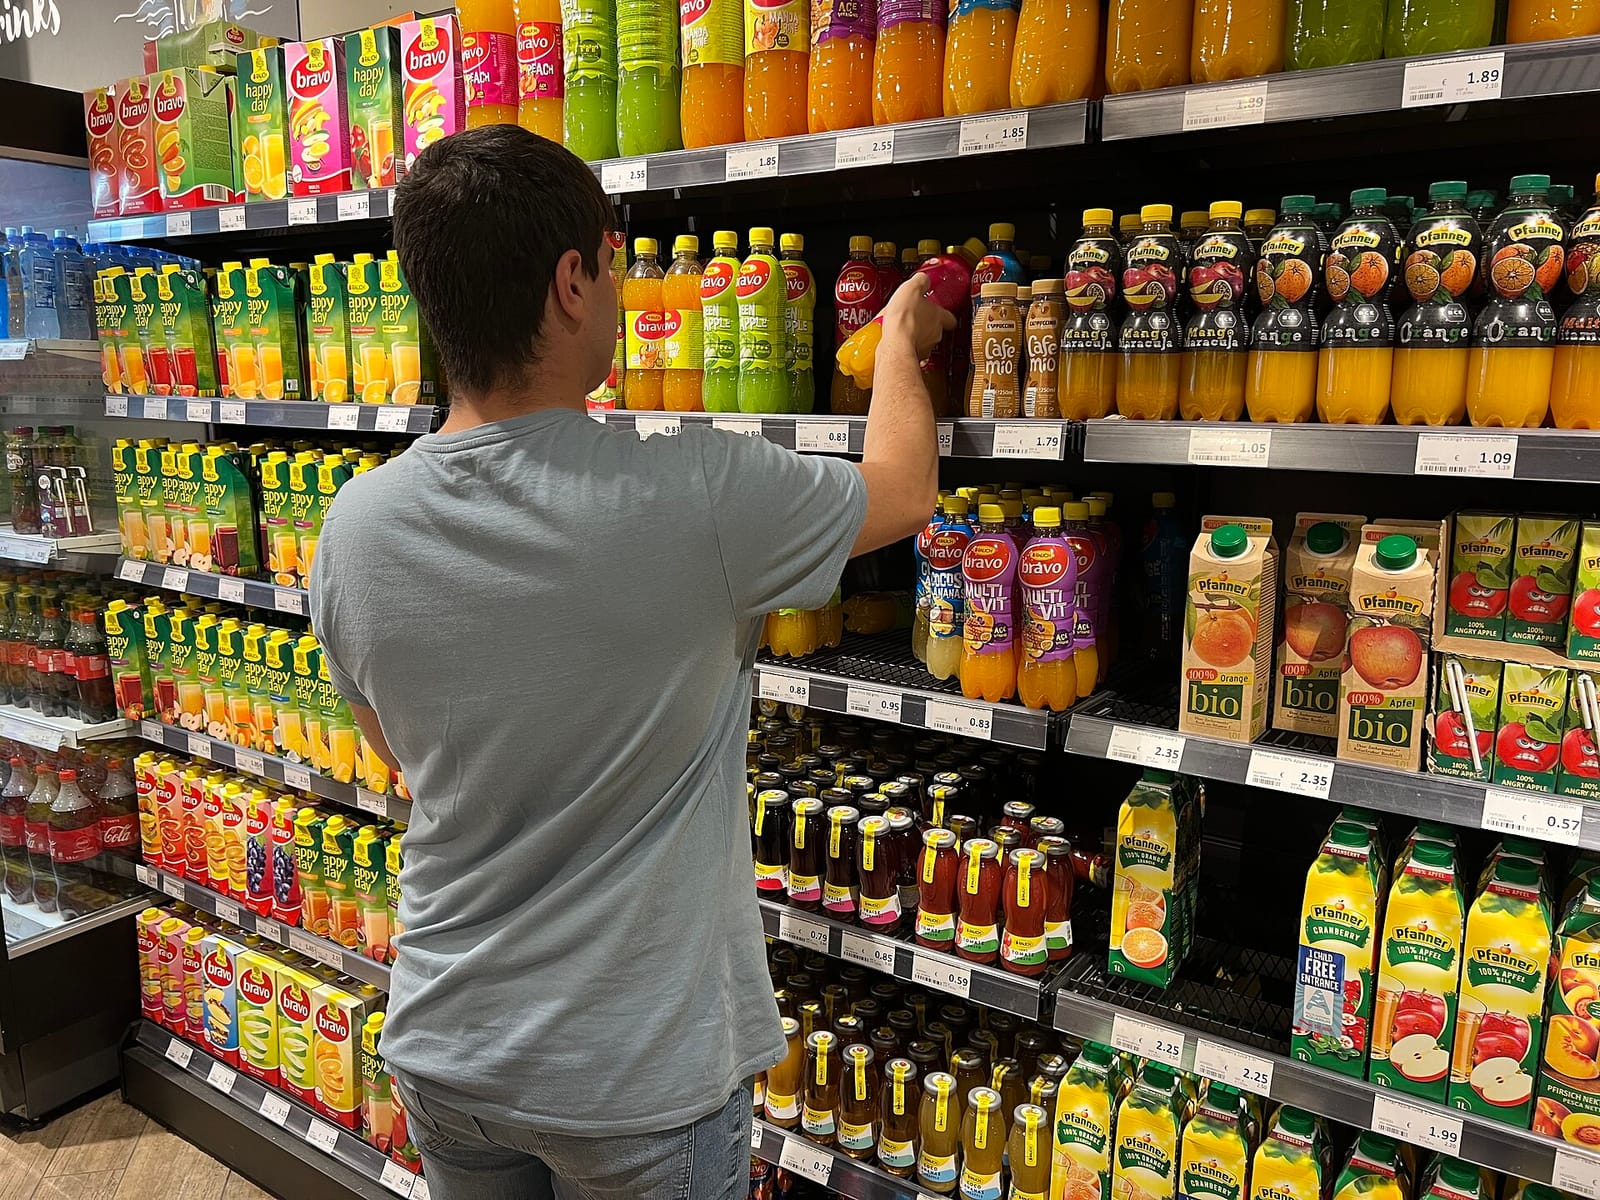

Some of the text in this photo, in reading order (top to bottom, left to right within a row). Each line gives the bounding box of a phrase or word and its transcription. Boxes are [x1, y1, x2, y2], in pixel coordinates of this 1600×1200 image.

[410, 51, 446, 70] bravo
[353, 66, 384, 84] happy
[527, 63, 554, 75] PEACH
[296, 70, 330, 89] bravo
[1467, 70, 1499, 84] 1.89
[245, 83, 273, 100] happy
[359, 83, 378, 98] day
[122, 103, 148, 118] bravo
[157, 93, 183, 113] bravo
[251, 99, 269, 114] day
[91, 112, 114, 127] bravo
[1002, 126, 1024, 139] 1.85
[873, 141, 892, 151] 2.55
[759, 156, 776, 167] 1.85
[630, 170, 645, 179] 2.55
[1421, 233, 1468, 244] Pfanner
[1513, 226, 1561, 239] Pfanner
[839, 282, 870, 293] bravo
[380, 294, 409, 311] appy
[312, 310, 327, 325] day
[350, 309, 369, 325] day
[382, 309, 401, 324] day
[839, 309, 872, 324] PEACH
[1064, 329, 1108, 338] Mango
[1122, 328, 1169, 339] Mango
[1188, 328, 1234, 338] Mango
[985, 337, 1015, 358] Cafe
[1028, 335, 1058, 355] Cafe
[986, 358, 1013, 374] mio
[1030, 356, 1055, 371] mio
[829, 432, 847, 442] 0.83
[1036, 437, 1058, 446] 1.79
[1240, 444, 1266, 453] 1.05
[1480, 453, 1511, 464] 1.09
[264, 503, 281, 516] day
[930, 546, 961, 558] bravo
[1462, 543, 1506, 555] Pfanner
[1522, 546, 1568, 560] Pfanner
[965, 556, 1002, 569] bravo
[1022, 562, 1061, 574] bravo
[966, 584, 1001, 598] MULTI
[1199, 578, 1247, 594] Pfanner
[1295, 578, 1344, 591] Pfanner
[1022, 588, 1063, 604] MULTI
[981, 597, 1004, 611] VIT
[1041, 603, 1065, 620] VIT
[1363, 597, 1419, 614] Pfanner
[1513, 632, 1556, 642] ANGRY APPLE
[220, 666, 235, 680] day
[1189, 670, 1248, 683] 100% Orange
[296, 688, 312, 703] day
[789, 685, 806, 694] 0.83
[1286, 682, 1333, 711] bio
[1466, 683, 1492, 696] nner
[882, 700, 900, 711] 0.95
[1191, 683, 1238, 716] bio
[1349, 694, 1415, 708] 100% Apfel
[1509, 692, 1558, 708] Pfanner
[970, 717, 990, 728] 0.83
[1353, 709, 1408, 745] bio
[1155, 747, 1179, 758] 2.35
[1300, 773, 1327, 786] 2.35
[1502, 780, 1547, 792] ANGRY APPLE
[1517, 774, 1534, 783] 100%
[1547, 816, 1579, 830] 0.57
[104, 824, 130, 842] Cola
[1125, 836, 1165, 853] Pfanner
[325, 866, 342, 882] day
[355, 878, 371, 894] day
[1316, 905, 1363, 924] Pfanner
[811, 931, 827, 941] 0.79
[1313, 926, 1360, 941] CRANBERRY
[1396, 927, 1448, 948] Pfanner
[875, 950, 892, 962] 0.85
[1314, 951, 1332, 961] CHILD
[1397, 944, 1441, 960] 100% APFEL
[1478, 949, 1533, 970] Pfanner
[208, 963, 232, 979] bravo
[1306, 958, 1336, 979] FREE
[1478, 967, 1525, 982] 100% APFEL
[949, 974, 968, 986] 0.59
[1301, 974, 1338, 990] ENTRANCE
[243, 983, 270, 998] bravo
[284, 995, 308, 1016] bravo
[319, 1015, 346, 1036] bravo
[1156, 1041, 1179, 1054] 2.25
[362, 1065, 377, 1081] day
[1243, 1068, 1268, 1084] 2.25
[1547, 1085, 1582, 1100] PFIRSICH
[1065, 1111, 1102, 1134] Pfanner
[1429, 1127, 1458, 1143] 1.99
[1125, 1136, 1165, 1156] Pfanner
[1191, 1161, 1234, 1183] Pfanner
[1190, 1179, 1232, 1196] CRANBERRY
